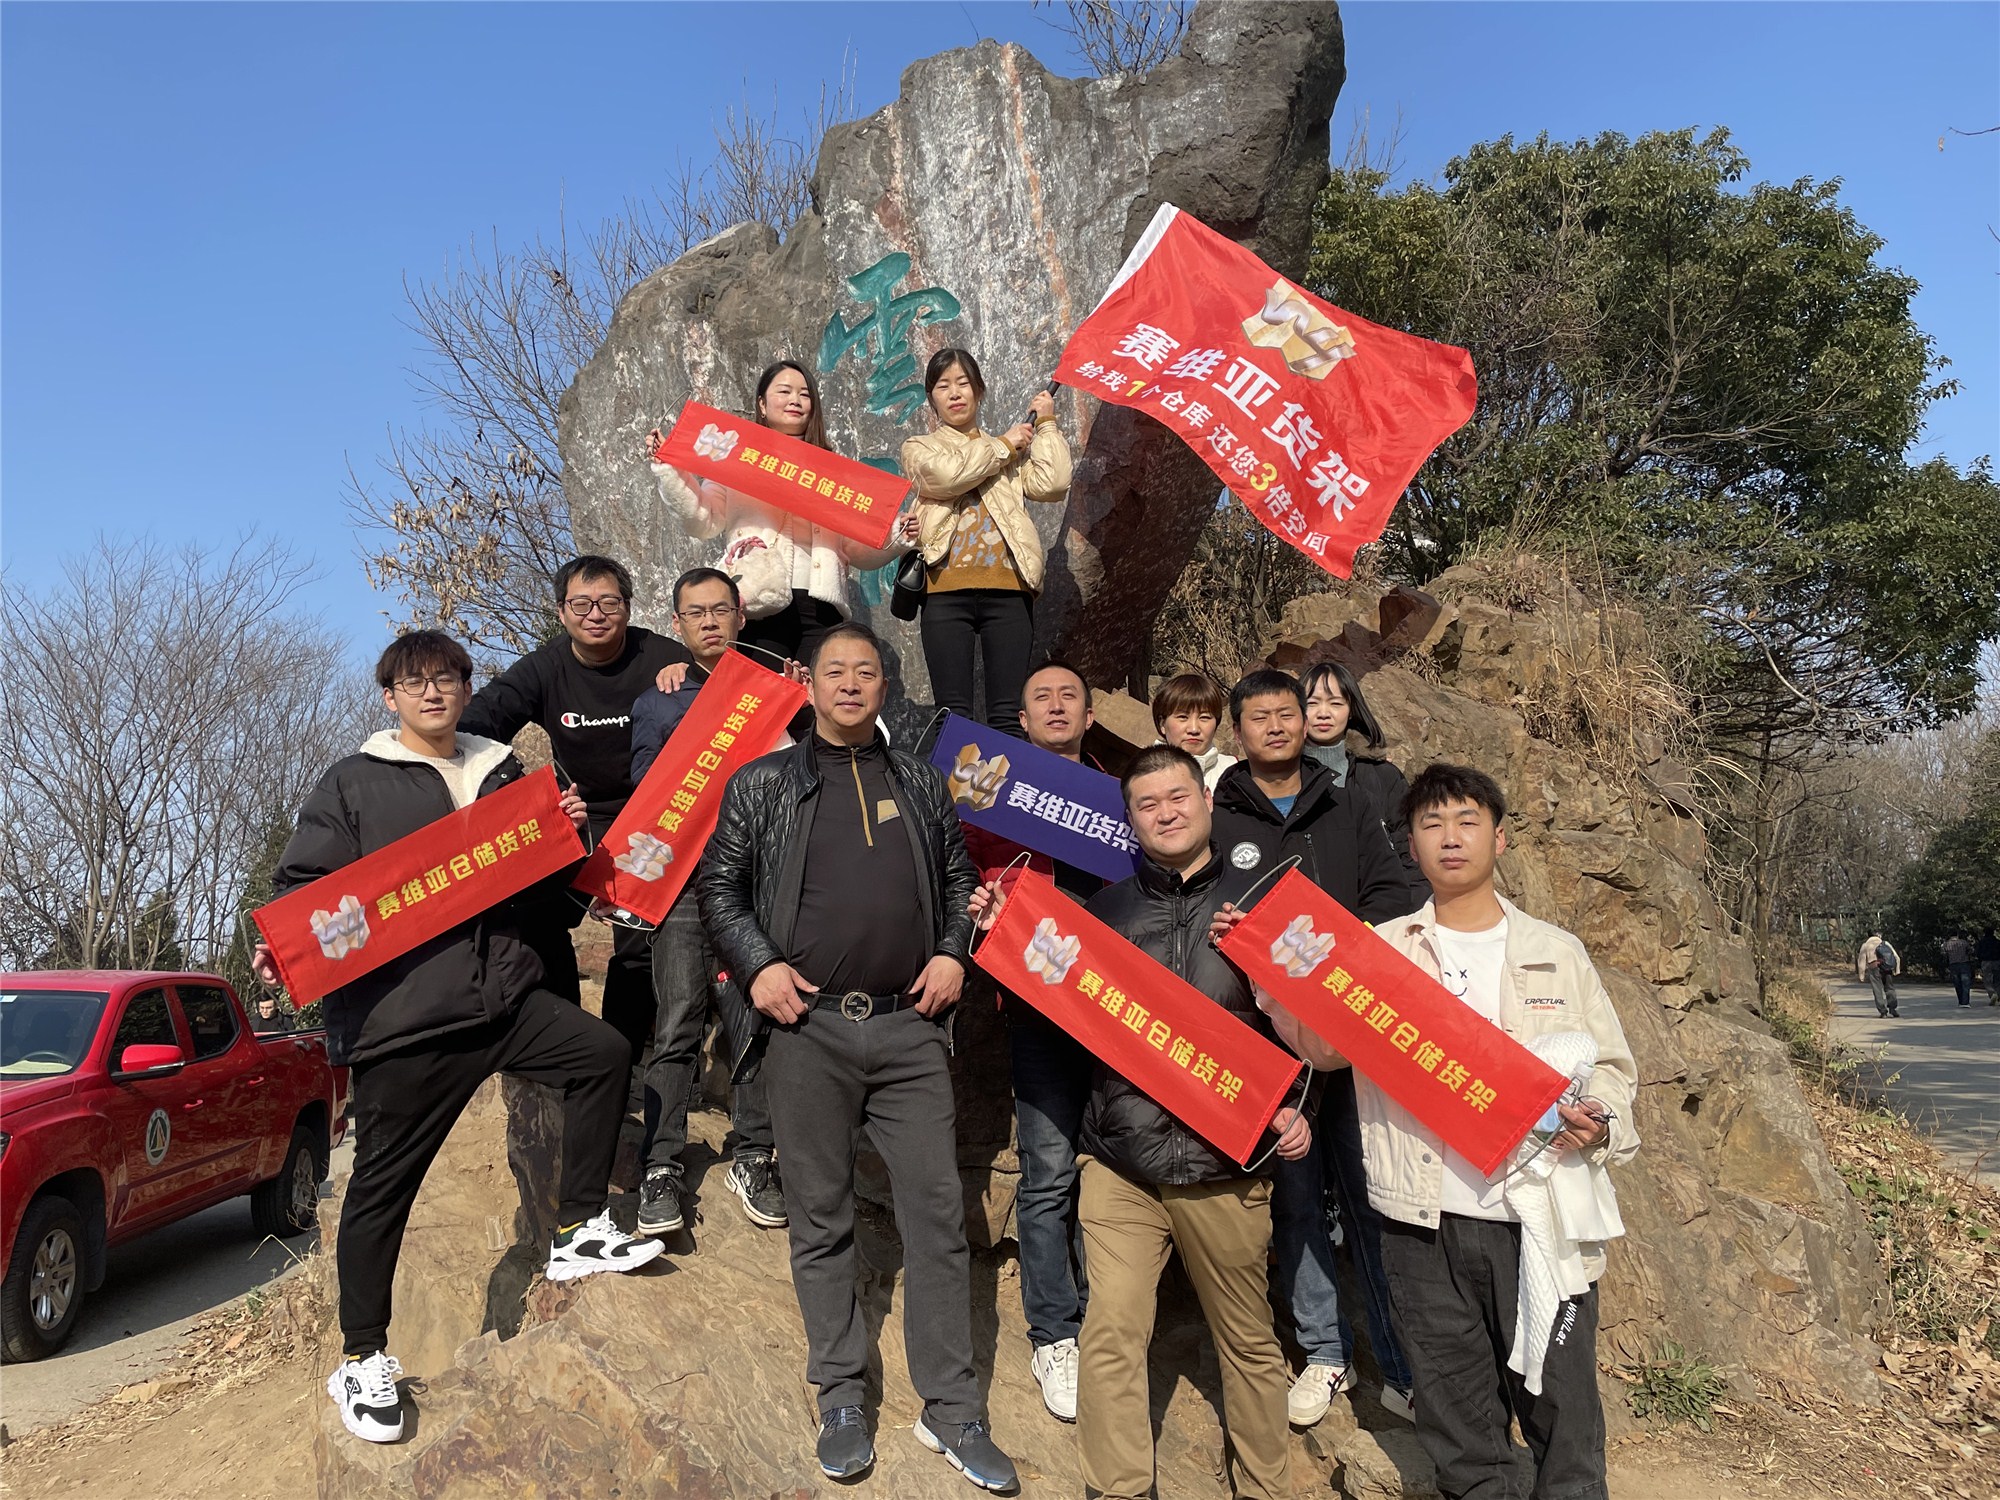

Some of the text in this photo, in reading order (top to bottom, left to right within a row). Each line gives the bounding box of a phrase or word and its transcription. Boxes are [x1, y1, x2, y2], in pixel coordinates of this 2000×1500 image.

[740, 447, 874, 513] 赛维亚仓储货架
[1075, 361, 1331, 556] 给我1个仓库还您3倍空间
[1112, 323, 1370, 522] 赛维亚货架
[561, 712, 631, 728] Champ
[657, 693, 763, 834] 赛维亚仓储货架
[376, 818, 543, 921] 赛维亚仓储货架
[1076, 968, 1244, 1103] 赛维亚仓储货架
[1321, 965, 1498, 1114] 赛维亚仓储货架
